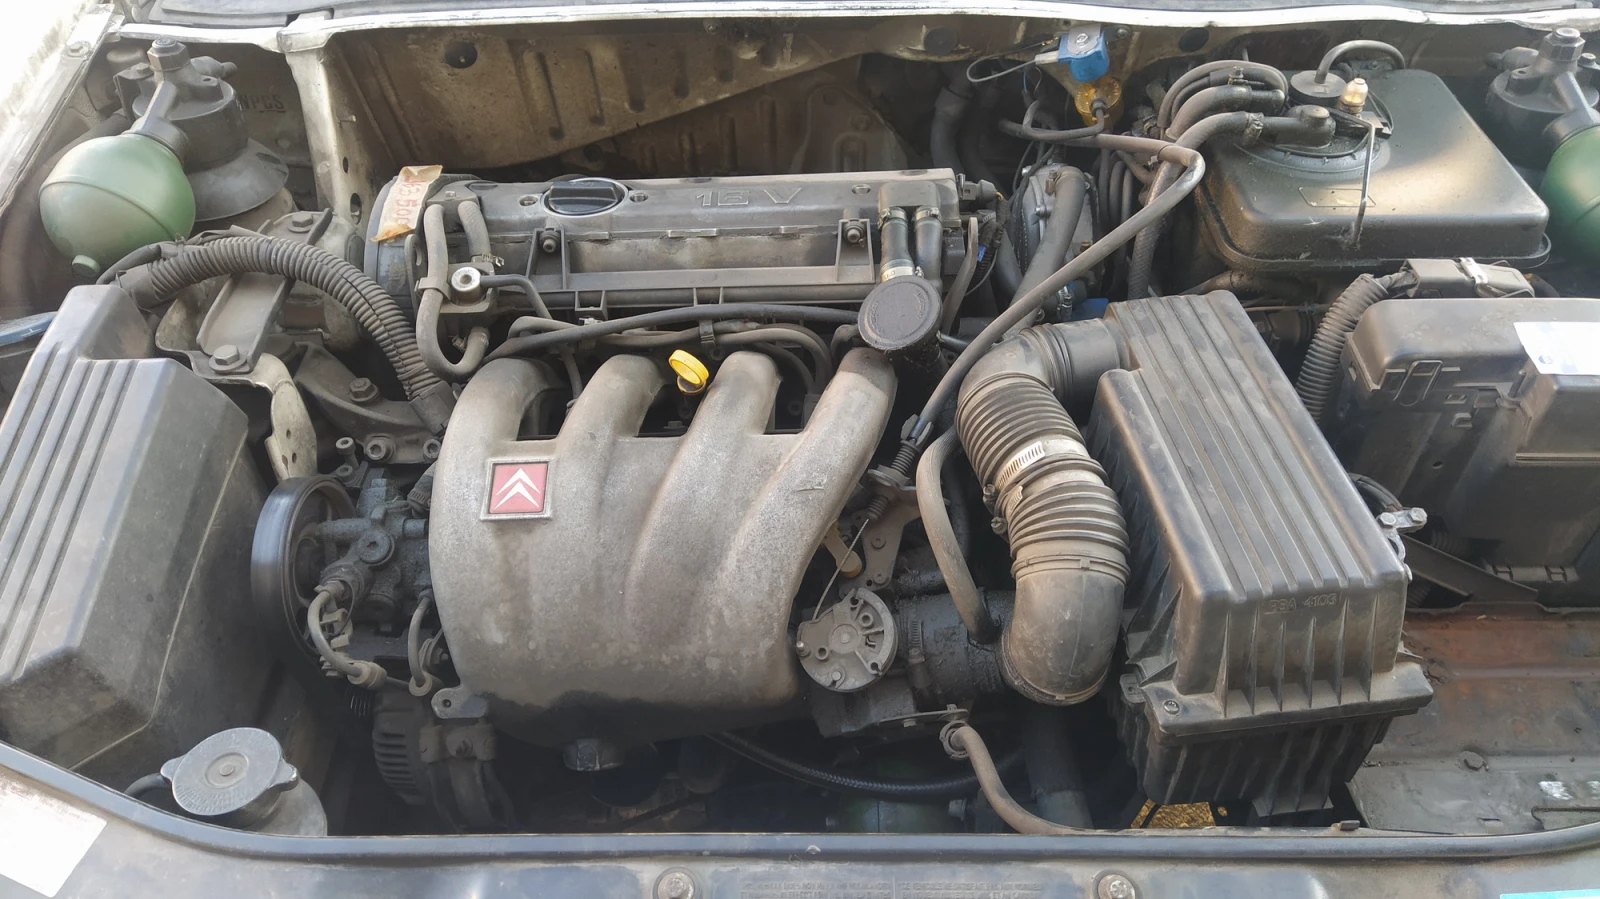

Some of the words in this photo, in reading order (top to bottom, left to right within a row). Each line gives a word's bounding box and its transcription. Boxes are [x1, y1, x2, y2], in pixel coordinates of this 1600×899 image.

[697, 190, 749, 206] 16
[763, 187, 802, 204] V
[1269, 598, 1298, 611] PSA
